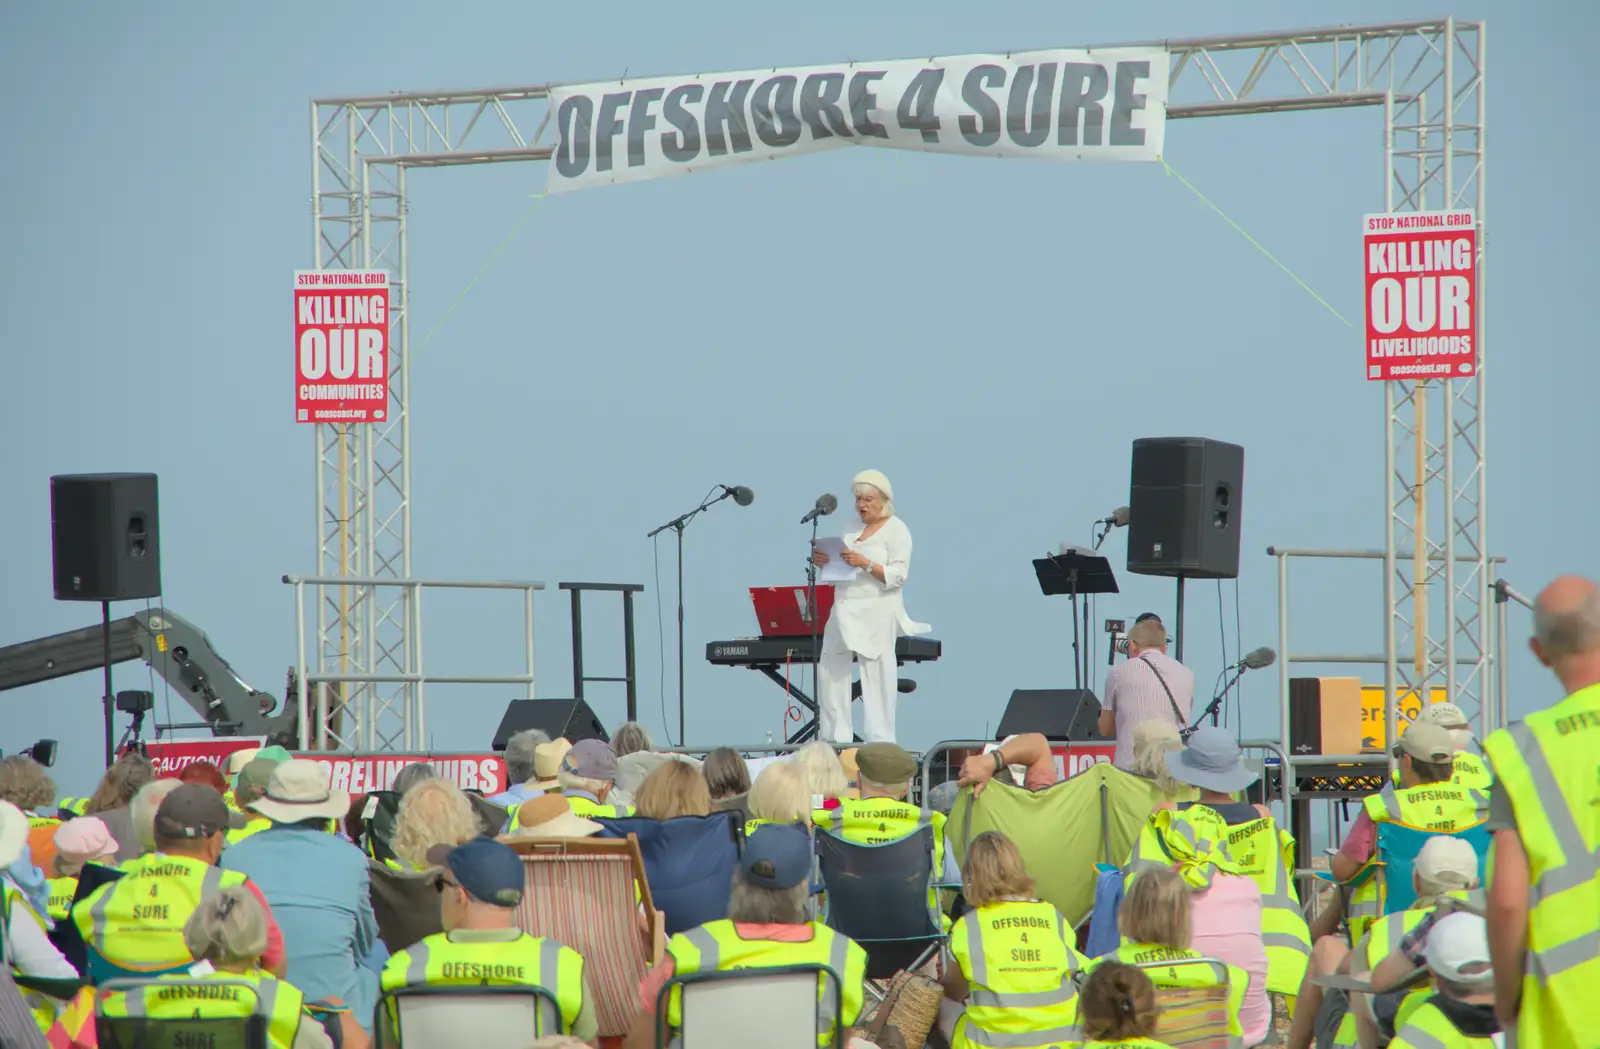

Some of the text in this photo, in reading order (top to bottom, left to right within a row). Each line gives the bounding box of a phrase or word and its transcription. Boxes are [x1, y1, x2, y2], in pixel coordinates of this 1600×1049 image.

[555, 60, 1151, 178] OFFSHORE 4 SURE
[1368, 213, 1472, 230] STOP NATIONAL GRID
[1369, 238, 1471, 274] KILLING
[298, 273, 386, 285] STOP NATIONAL GRID
[298, 294, 386, 325] KILLING
[1371, 275, 1471, 334] OUR
[300, 327, 384, 381] OUR
[1371, 335, 1471, 358] LIVELIHOODS
[299, 383, 384, 401] COMMUNITIES
[722, 646, 749, 656] YAMAHA
[878, 822, 887, 833] 4
[149, 883, 158, 898] 4
[132, 903, 169, 921] SURE
[992, 916, 1051, 930] OFFSHORE
[1020, 931, 1028, 944] 4
[1011, 948, 1041, 962] SURE
[442, 962, 525, 979] OFFSHORE
[1168, 966, 1177, 980] 4
